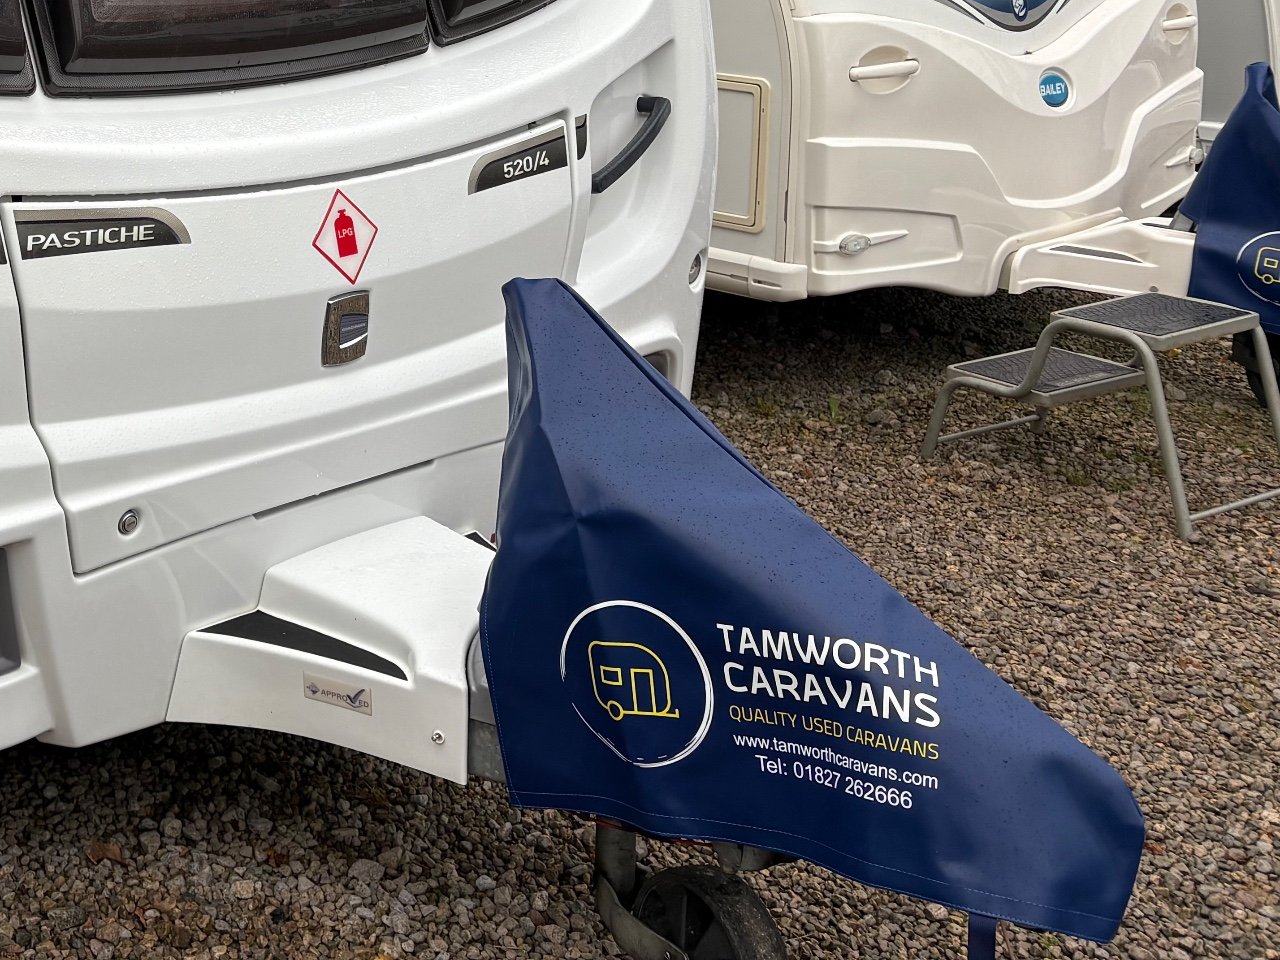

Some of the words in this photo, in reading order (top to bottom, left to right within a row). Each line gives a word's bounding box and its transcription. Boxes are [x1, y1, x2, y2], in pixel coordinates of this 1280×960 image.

[1040, 82, 1066, 96] BAILEY
[503, 150, 550, 179] 520/4
[26, 224, 155, 251] PASTICHE
[337, 227, 353, 239] LPG
[716, 623, 939, 687] TAMWORTH
[321, 688, 369, 708] APPROVED
[723, 661, 941, 728] CARAVANS
[729, 705, 797, 728] QUALITY
[801, 716, 843, 738] USED
[846, 725, 940, 760] CARAVANS
[733, 734, 939, 790] www.tamworthcaravans.com
[755, 754, 788, 776] Tel:
[793, 761, 841, 789] 01827
[845, 776, 913, 809] 262666
